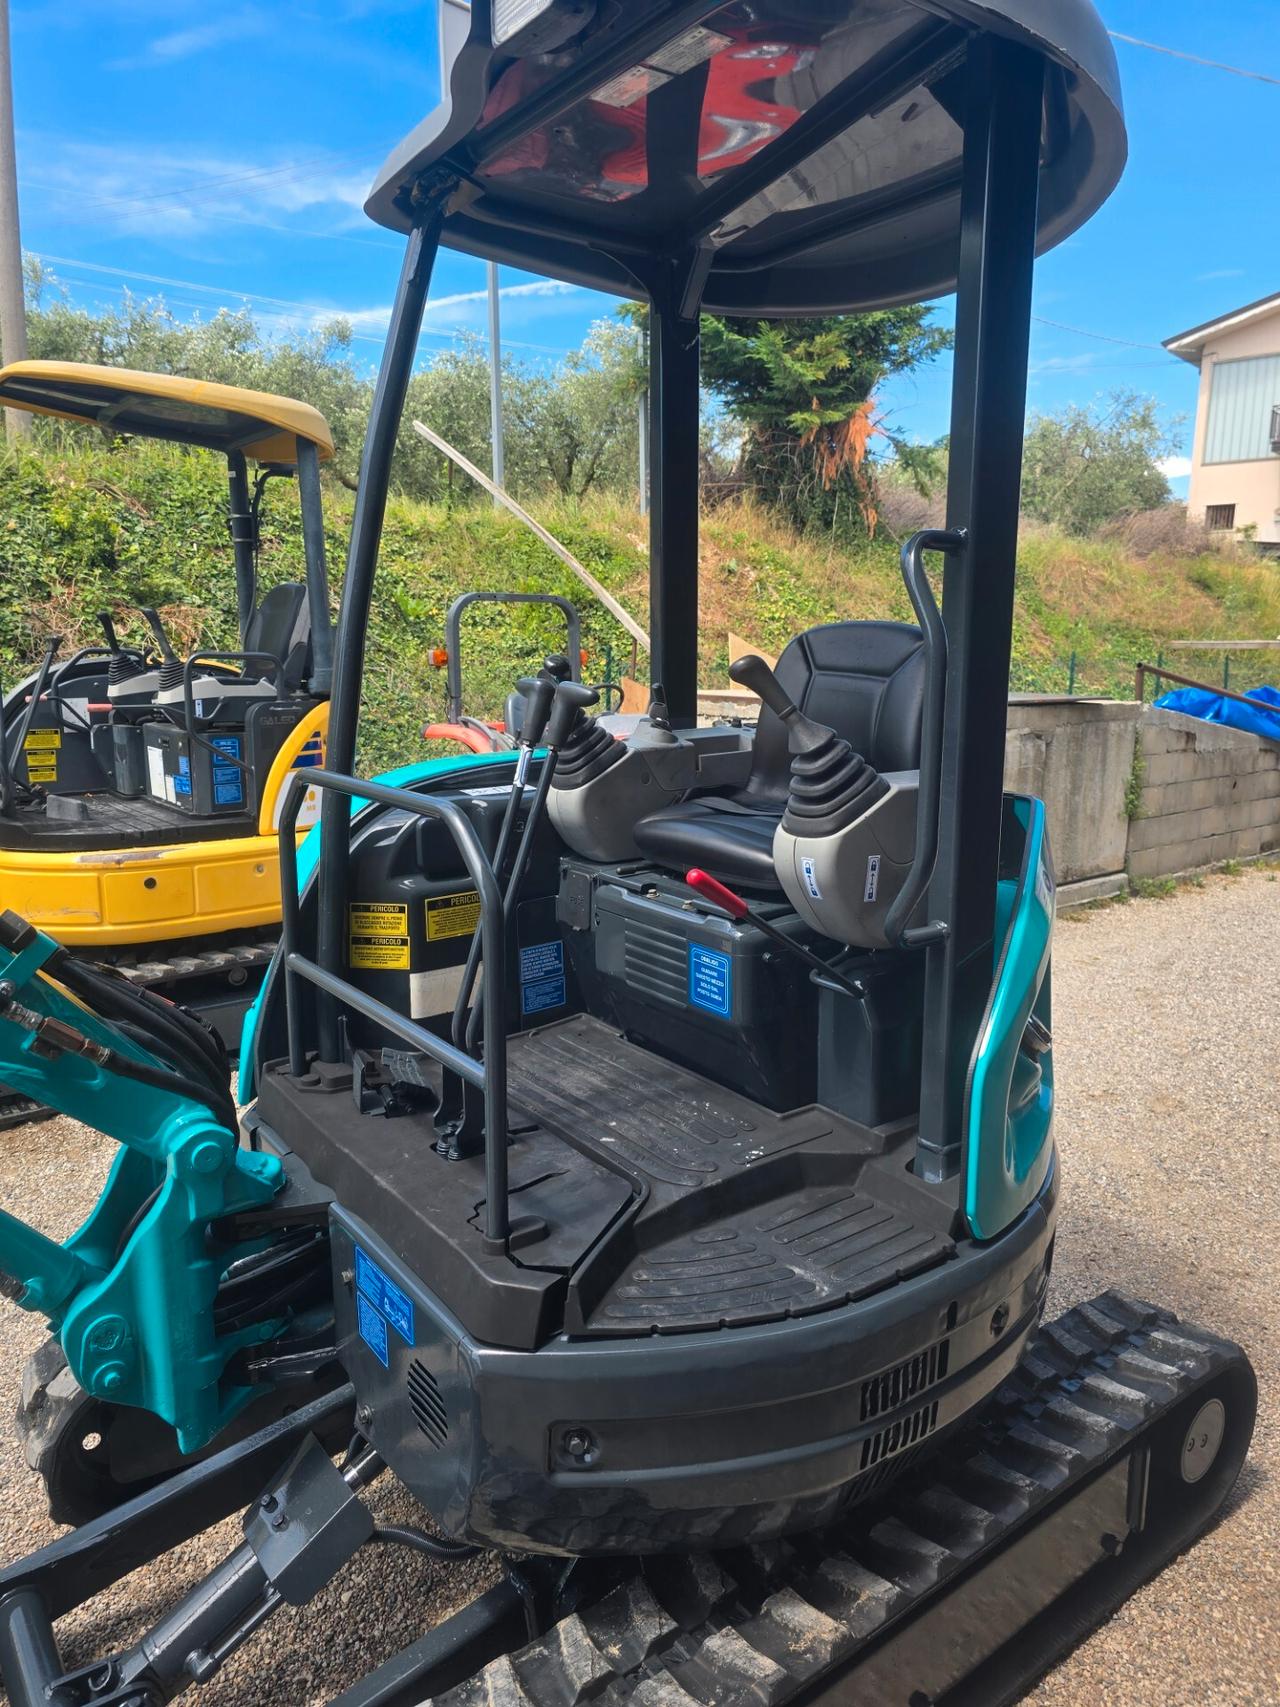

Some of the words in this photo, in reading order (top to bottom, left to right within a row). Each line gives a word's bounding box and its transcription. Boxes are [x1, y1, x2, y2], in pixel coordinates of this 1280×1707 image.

[450, 894, 481, 906] PERICOL
[370, 905, 400, 913] PERICOLO
[371, 938, 402, 946] PERICOLO
[700, 955, 719, 966] OBBLIGO
